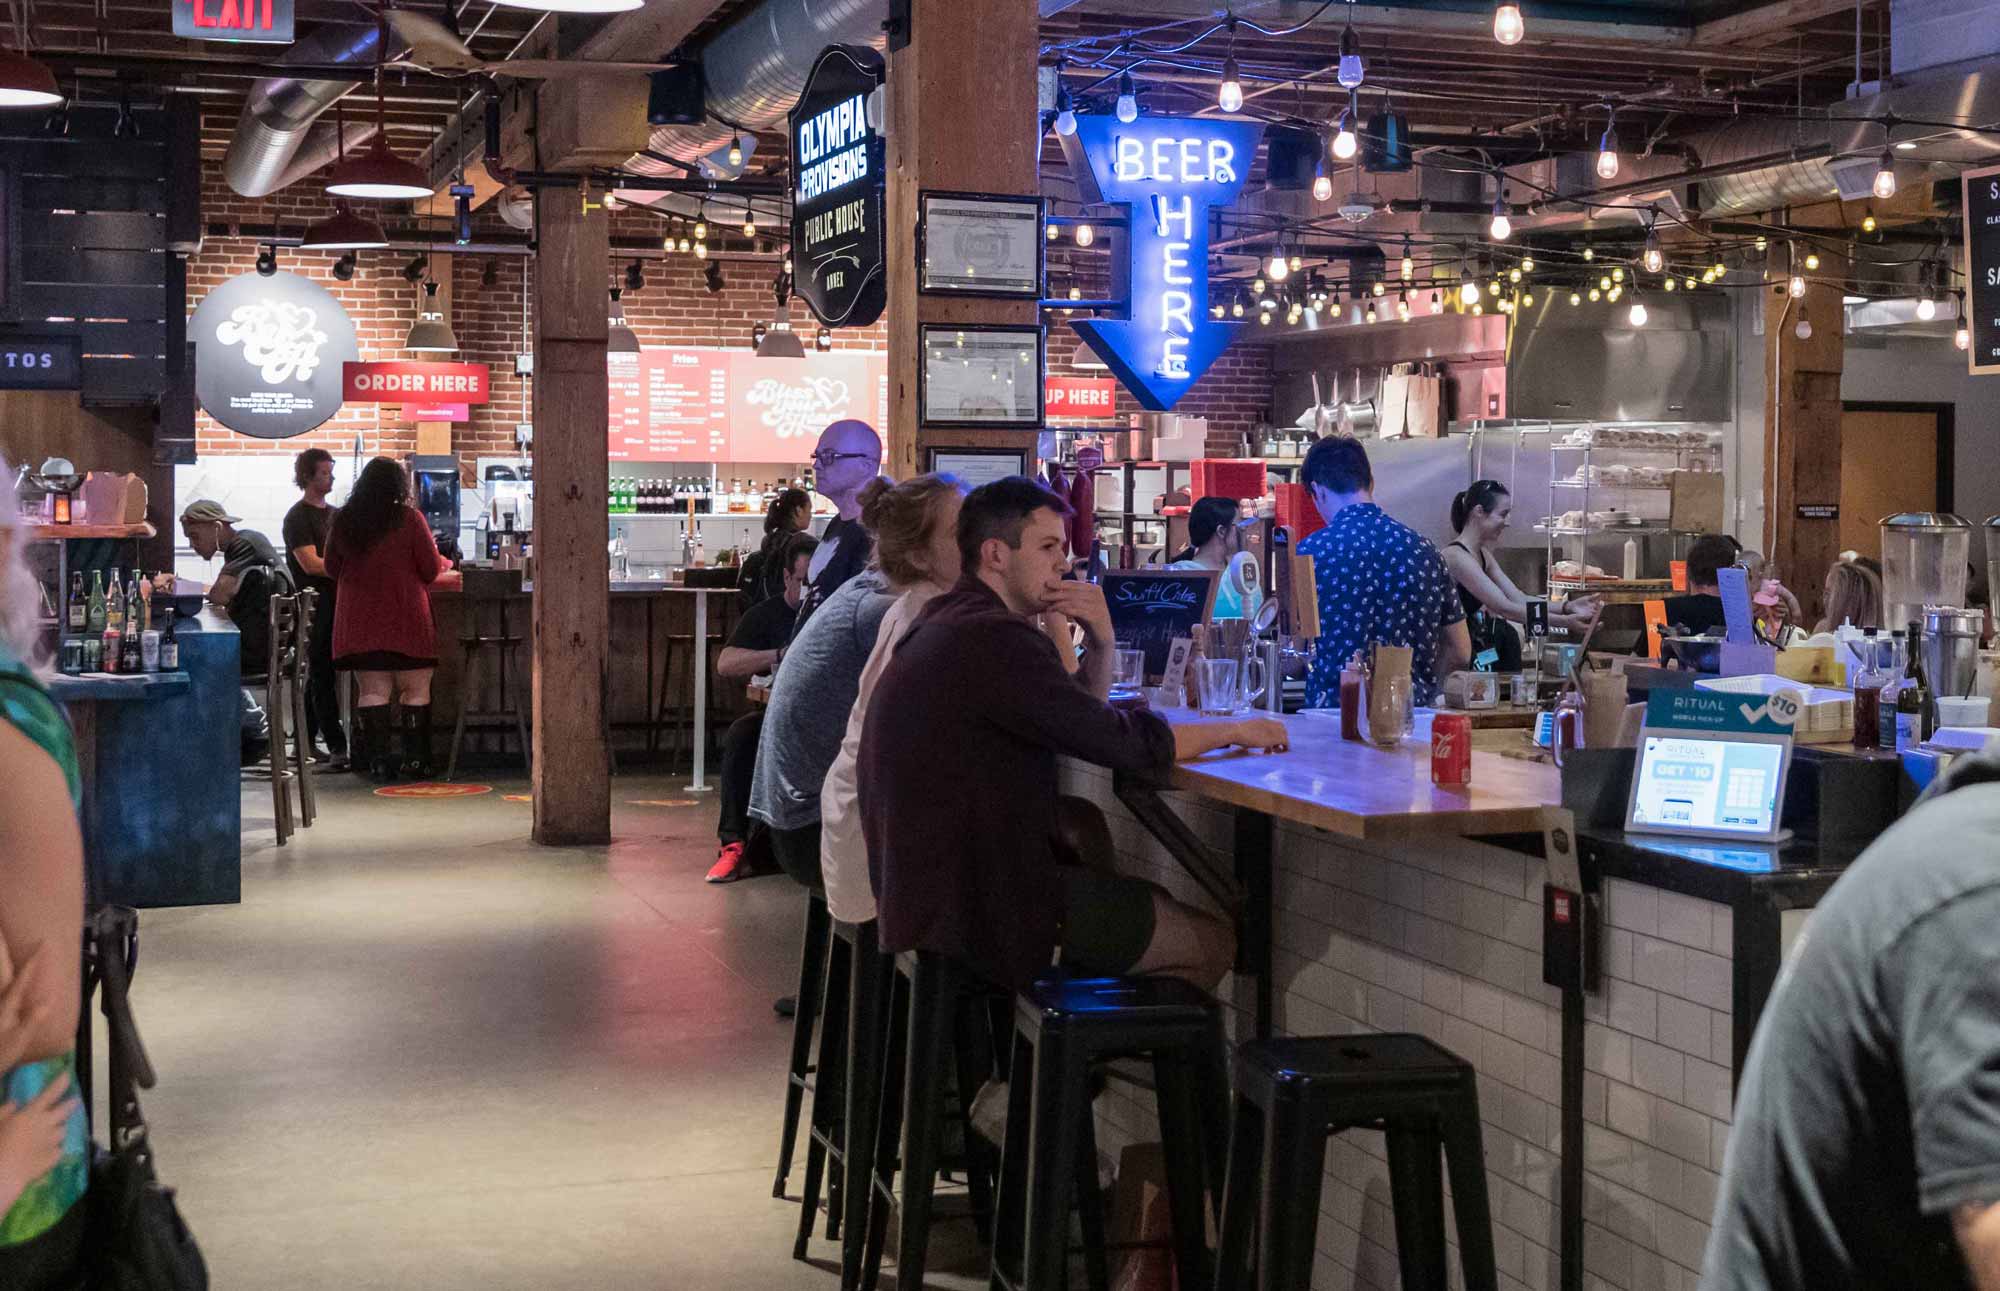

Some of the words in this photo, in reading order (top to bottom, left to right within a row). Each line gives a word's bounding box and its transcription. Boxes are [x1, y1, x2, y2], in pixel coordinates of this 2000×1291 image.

[800, 94, 867, 166] OLYMPIA
[1117, 137, 1237, 183] BEER
[801, 143, 867, 200] PROVISIONS
[804, 211, 833, 252] PUBLIC
[835, 198, 866, 235] HOUSE
[826, 271, 844, 291] ANNEX
[1158, 195, 1194, 379] HERE
[354, 374, 425, 391] ORDER
[430, 375, 478, 392] HERE
[1046, 388, 1064, 404] UP
[1068, 389, 1109, 405] HERE
[1534, 603, 1541, 618] 1
[1673, 697, 1725, 711] RITUAL
[1771, 696, 1798, 716] $10
[1657, 765, 1685, 776] GET
